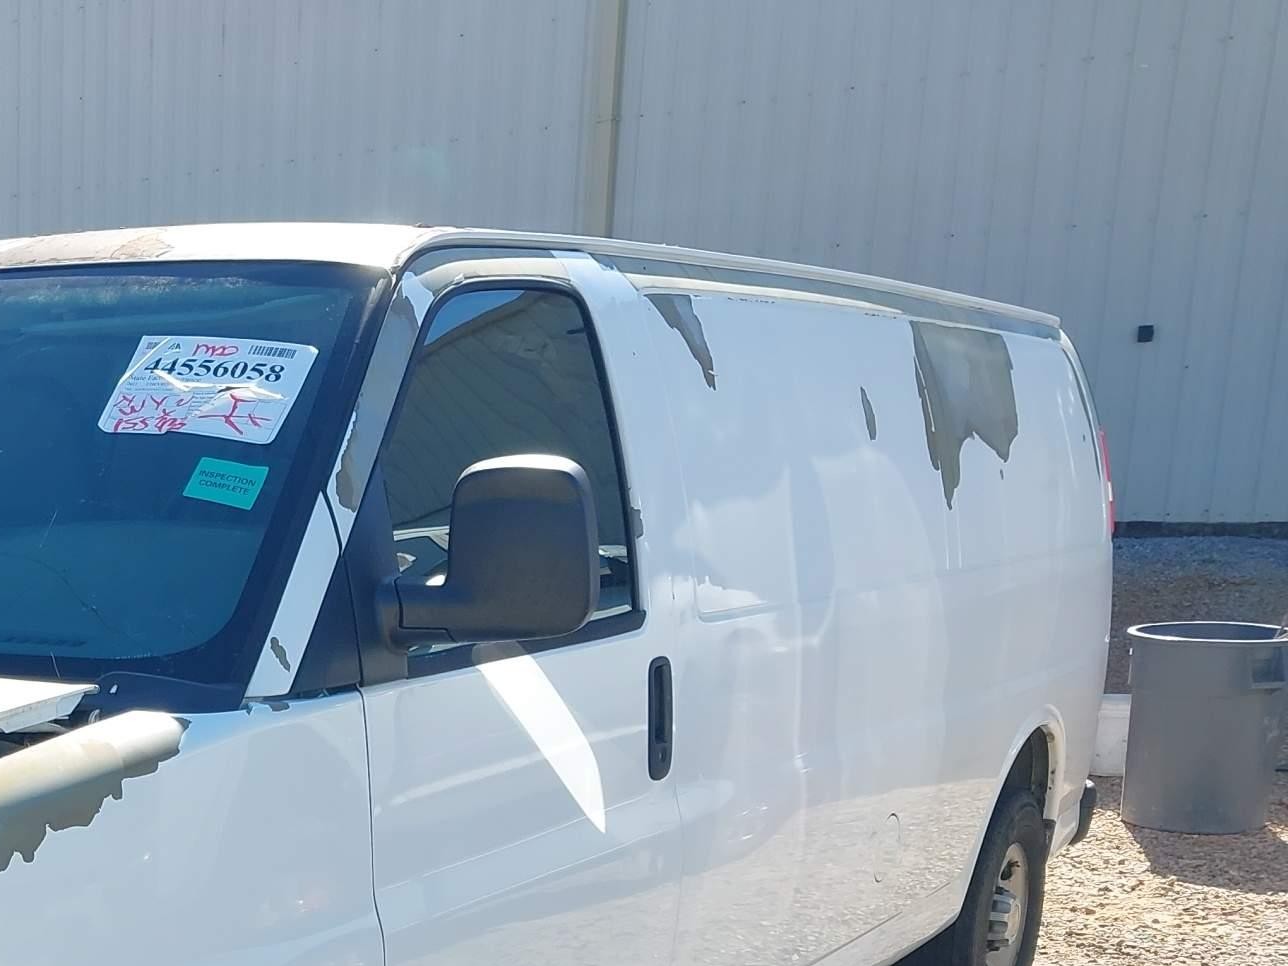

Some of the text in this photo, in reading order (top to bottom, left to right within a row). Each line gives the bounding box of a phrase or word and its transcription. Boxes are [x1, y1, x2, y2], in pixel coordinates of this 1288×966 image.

[144, 357, 285, 383] 44556058
[199, 470, 256, 487] INSPECTION
[199, 479, 249, 496] COMPLETE
